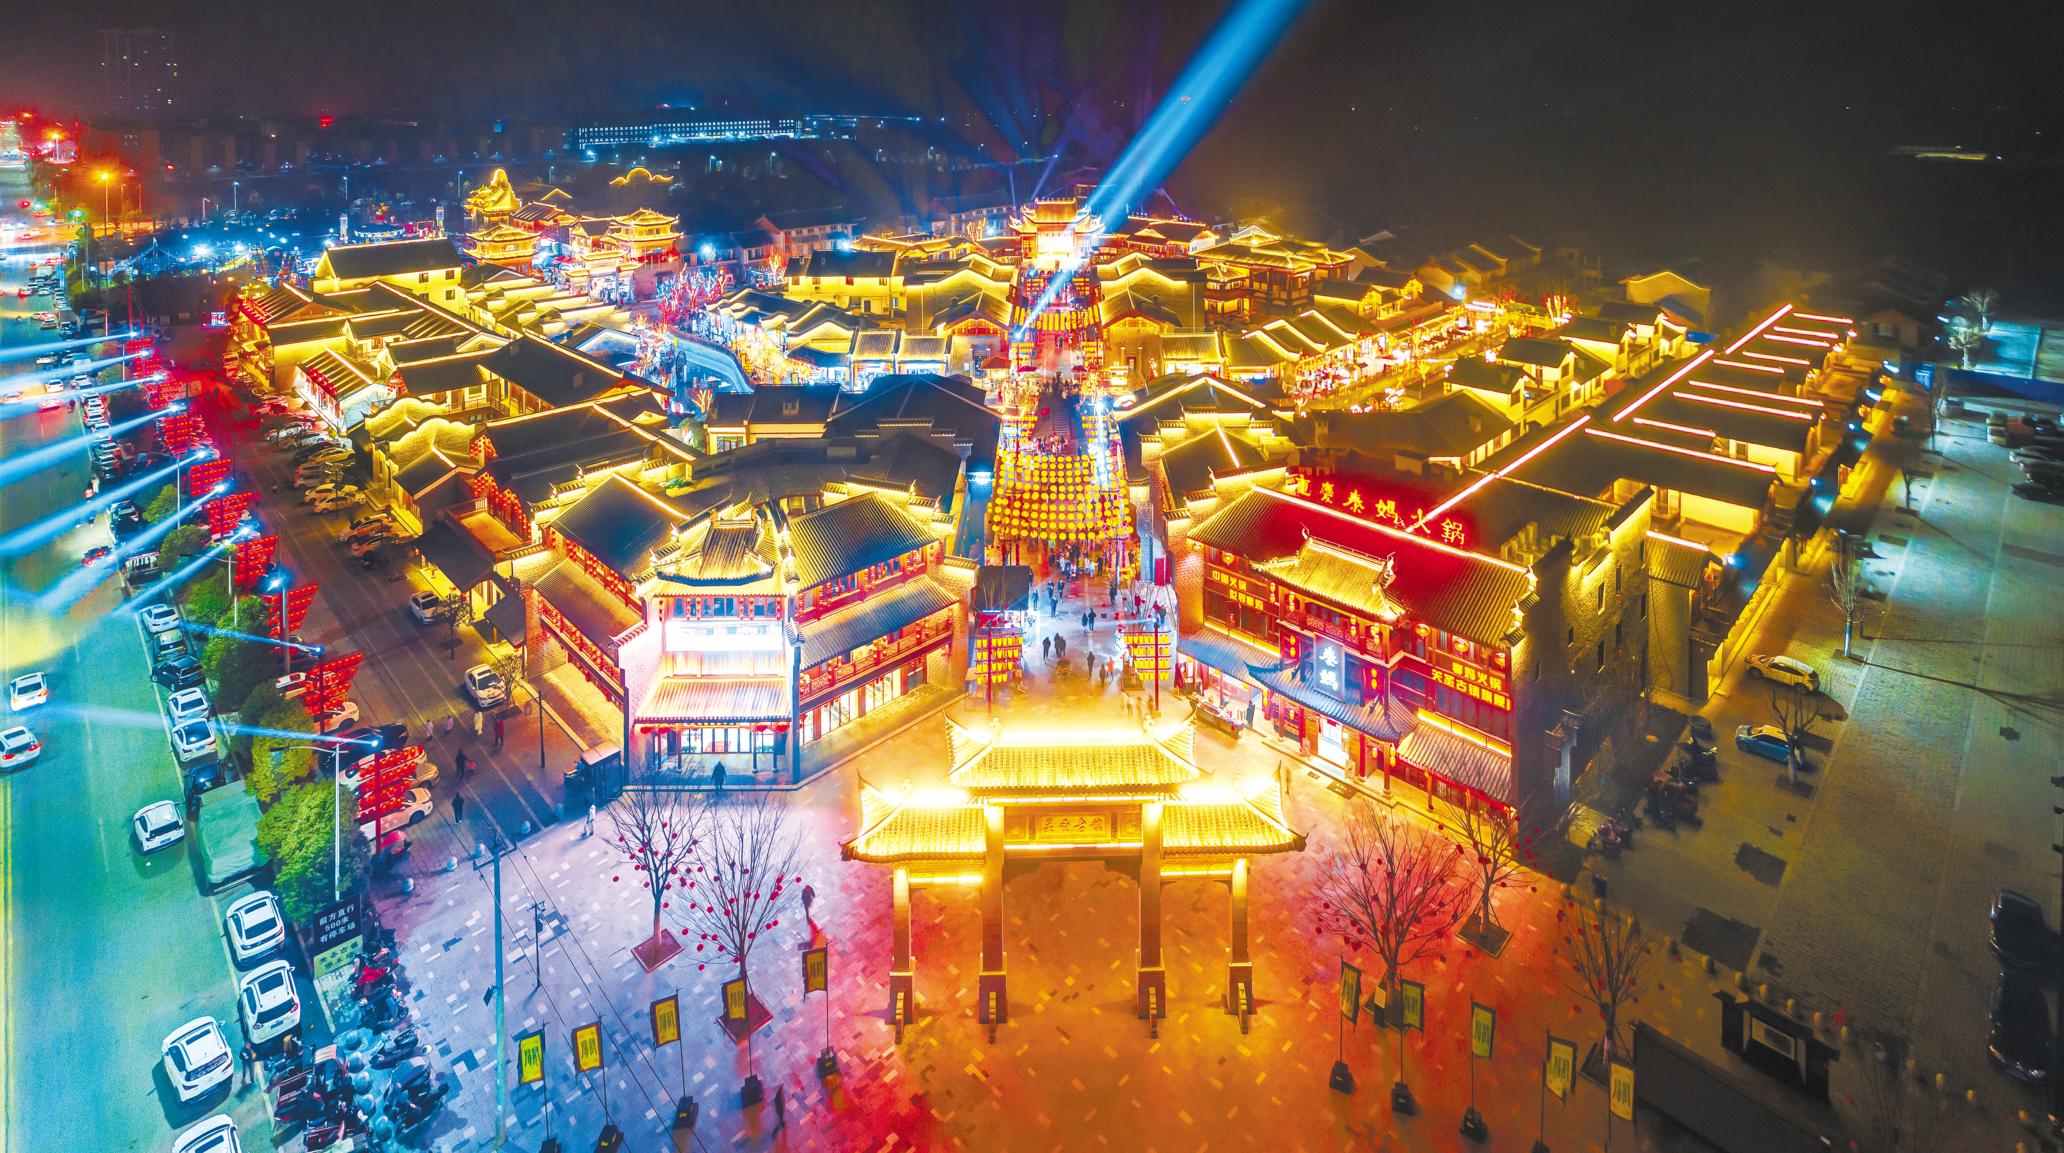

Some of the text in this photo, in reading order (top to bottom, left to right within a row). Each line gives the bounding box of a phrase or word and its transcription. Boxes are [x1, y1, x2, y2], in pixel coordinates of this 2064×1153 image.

[1212, 570, 1247, 591] 中国火锅
[319, 904, 355, 926] 前方直行
[325, 916, 349, 932] 500米
[319, 921, 356, 943] 有停车场
